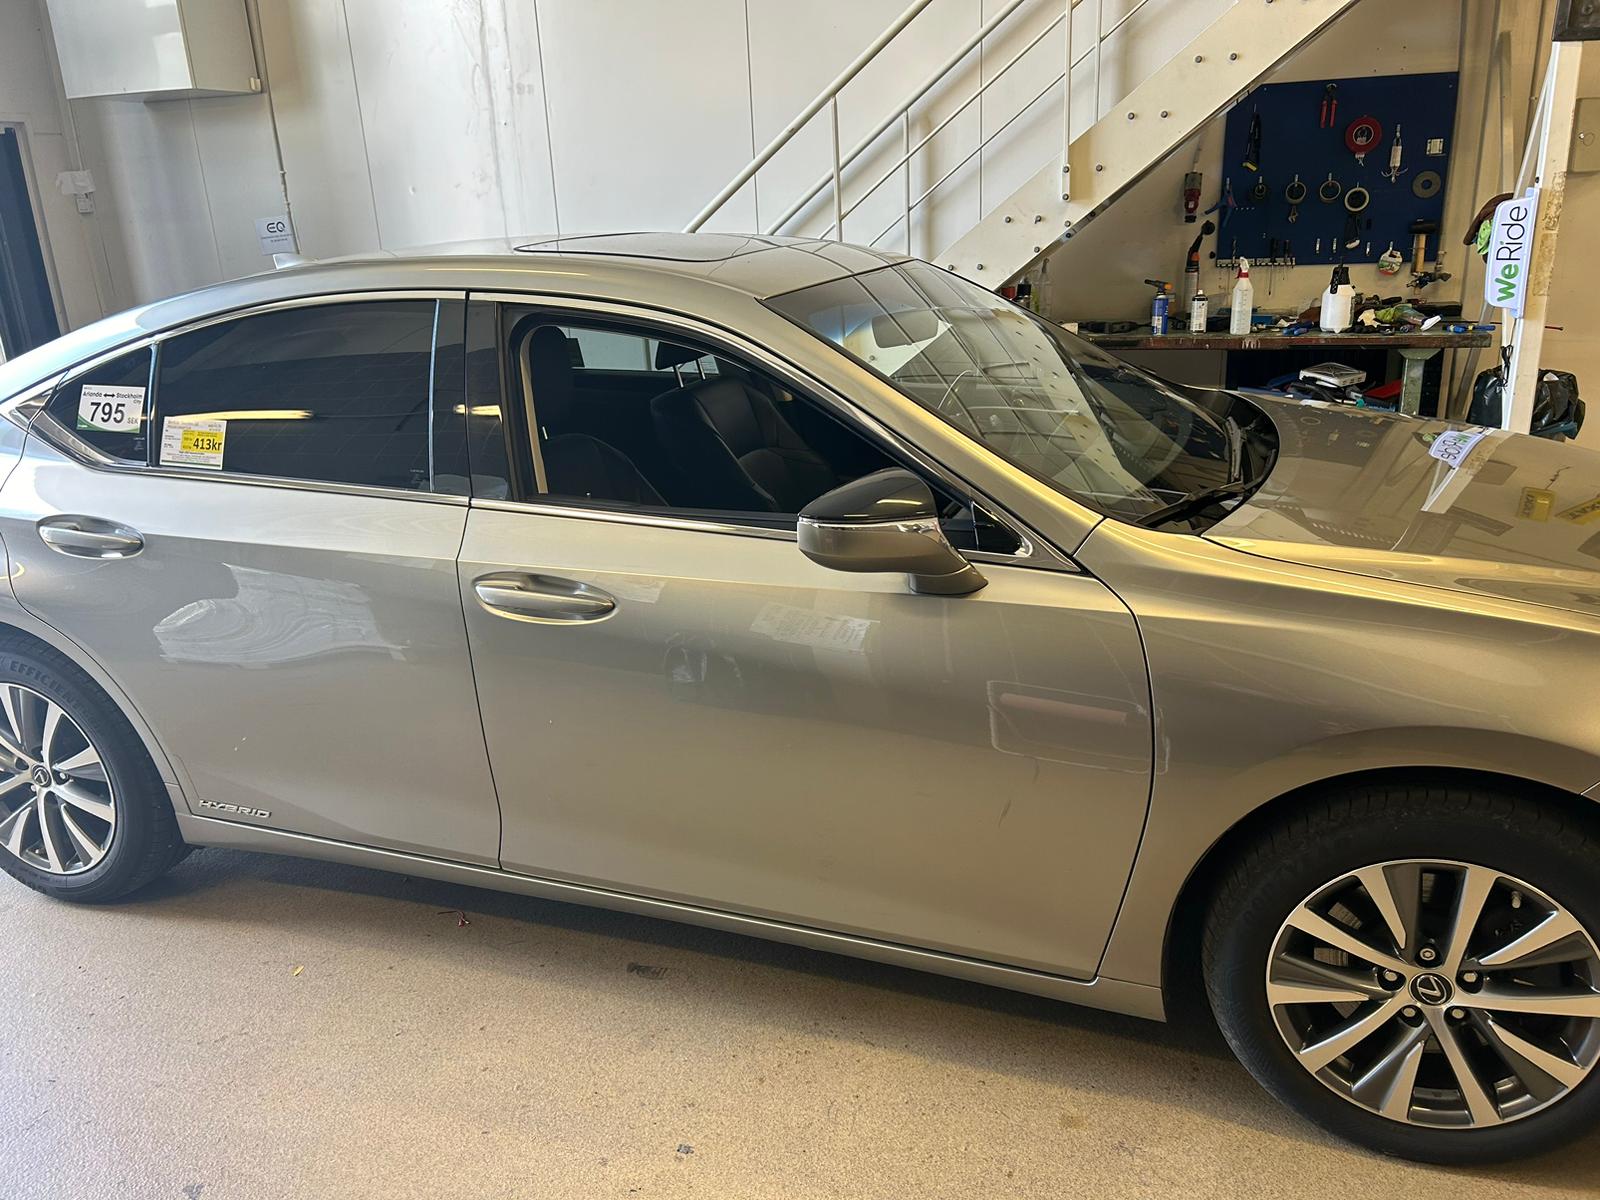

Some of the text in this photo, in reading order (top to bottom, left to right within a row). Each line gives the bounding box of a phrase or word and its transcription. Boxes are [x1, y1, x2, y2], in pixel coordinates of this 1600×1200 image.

[1494, 206, 1528, 302] WeRide
[90, 401, 139, 425] 795 SEK
[193, 437, 223, 452] 413kr
[199, 800, 272, 818] HYBRID
